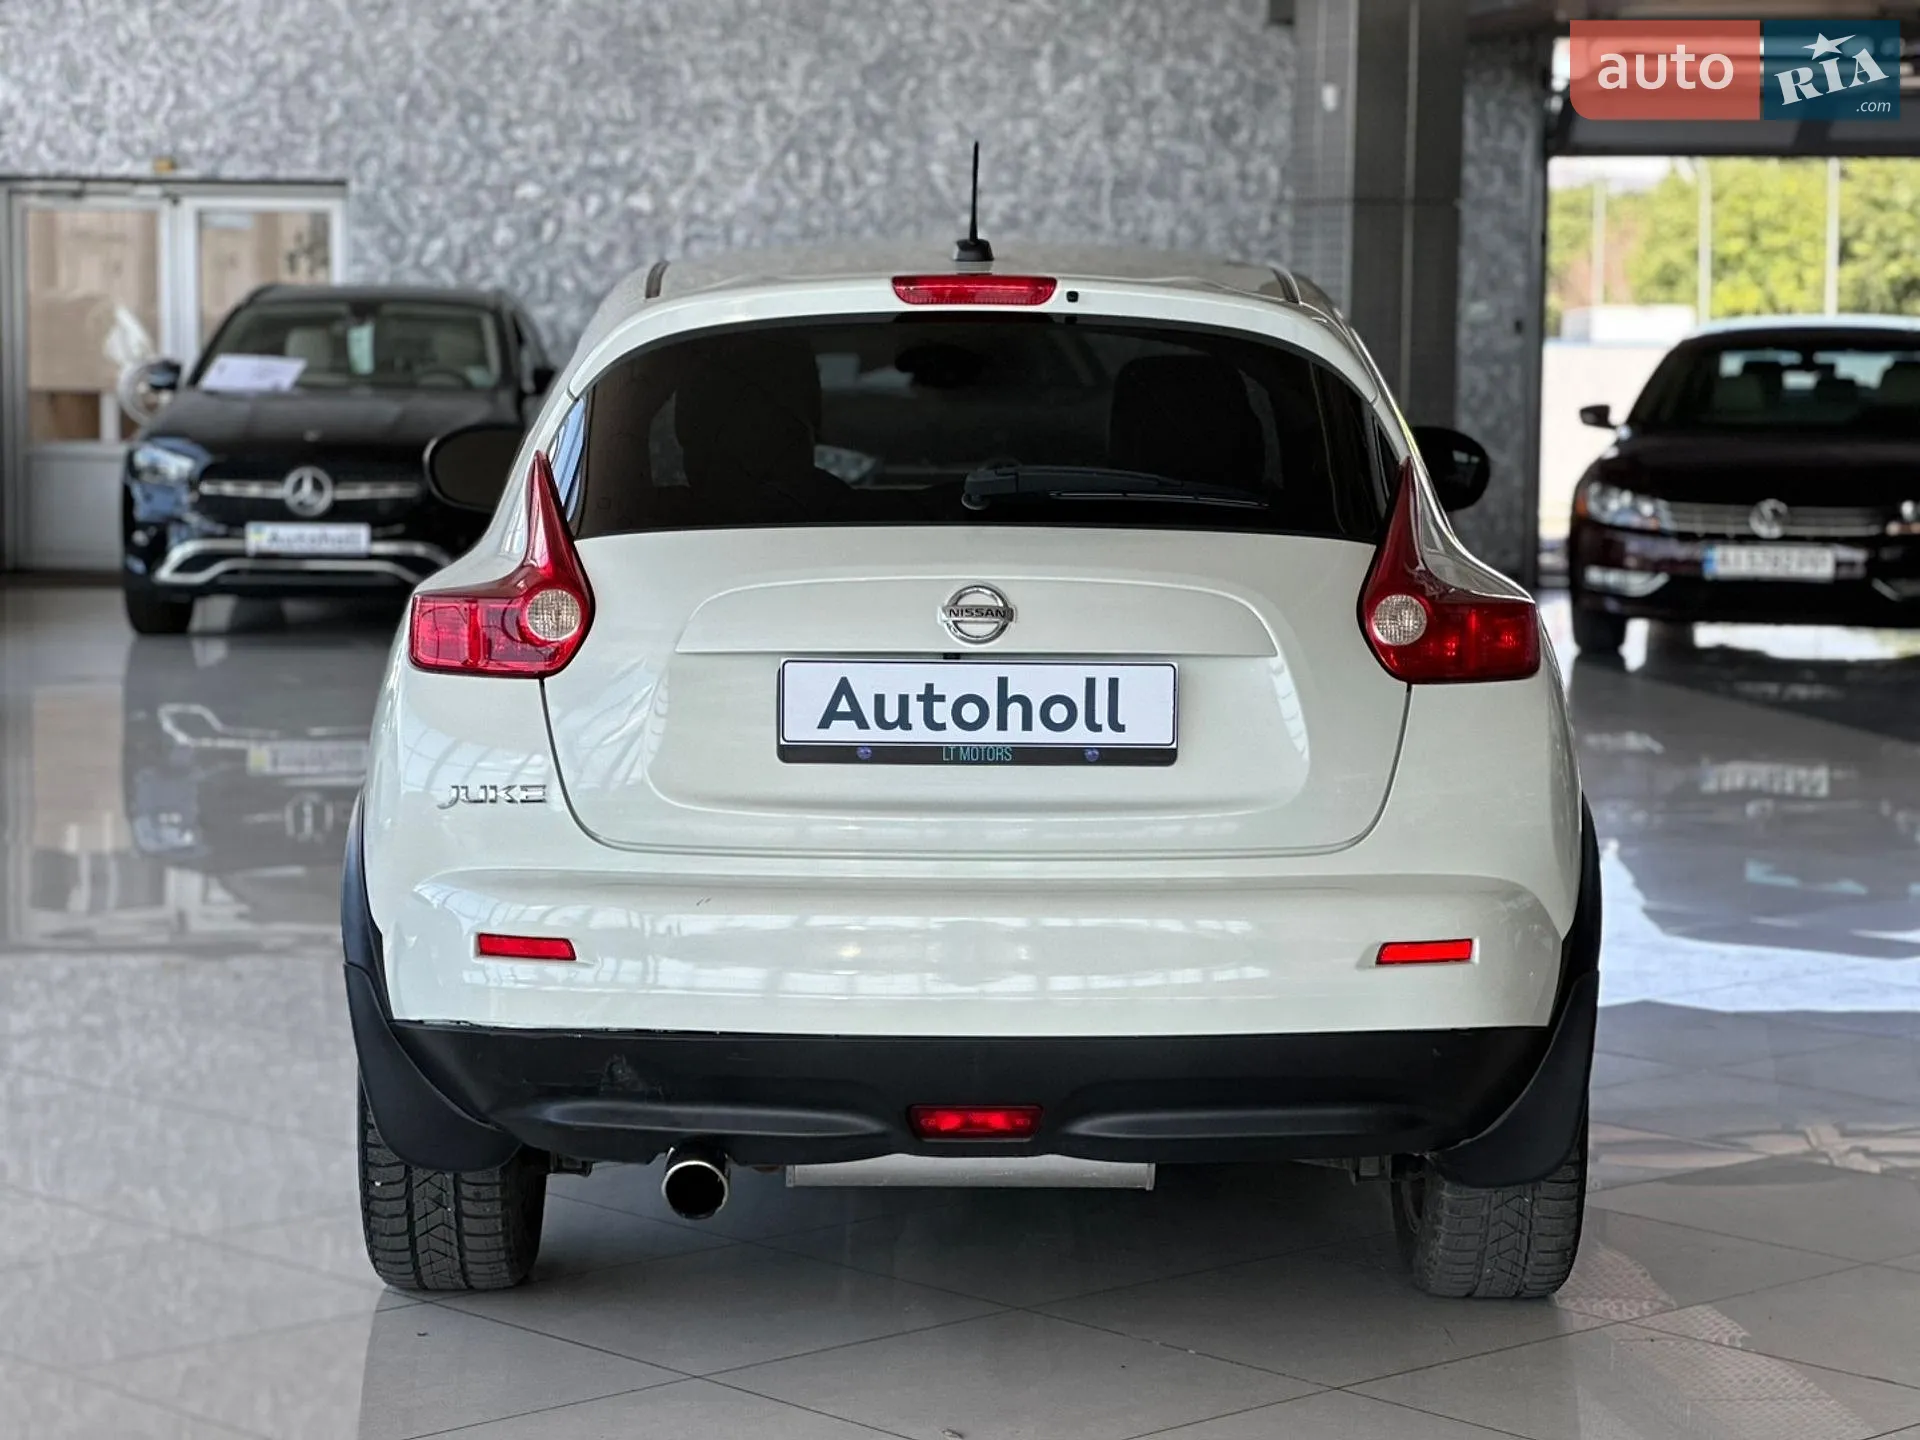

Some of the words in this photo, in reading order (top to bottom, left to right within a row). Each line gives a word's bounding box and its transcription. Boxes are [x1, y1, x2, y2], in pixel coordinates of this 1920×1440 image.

[949, 608, 1006, 618] NISSAN
[817, 676, 1126, 733] Autoholl
[942, 745, 956, 761] LT
[960, 745, 1012, 761] MOTORS
[437, 784, 547, 809] JUKE
